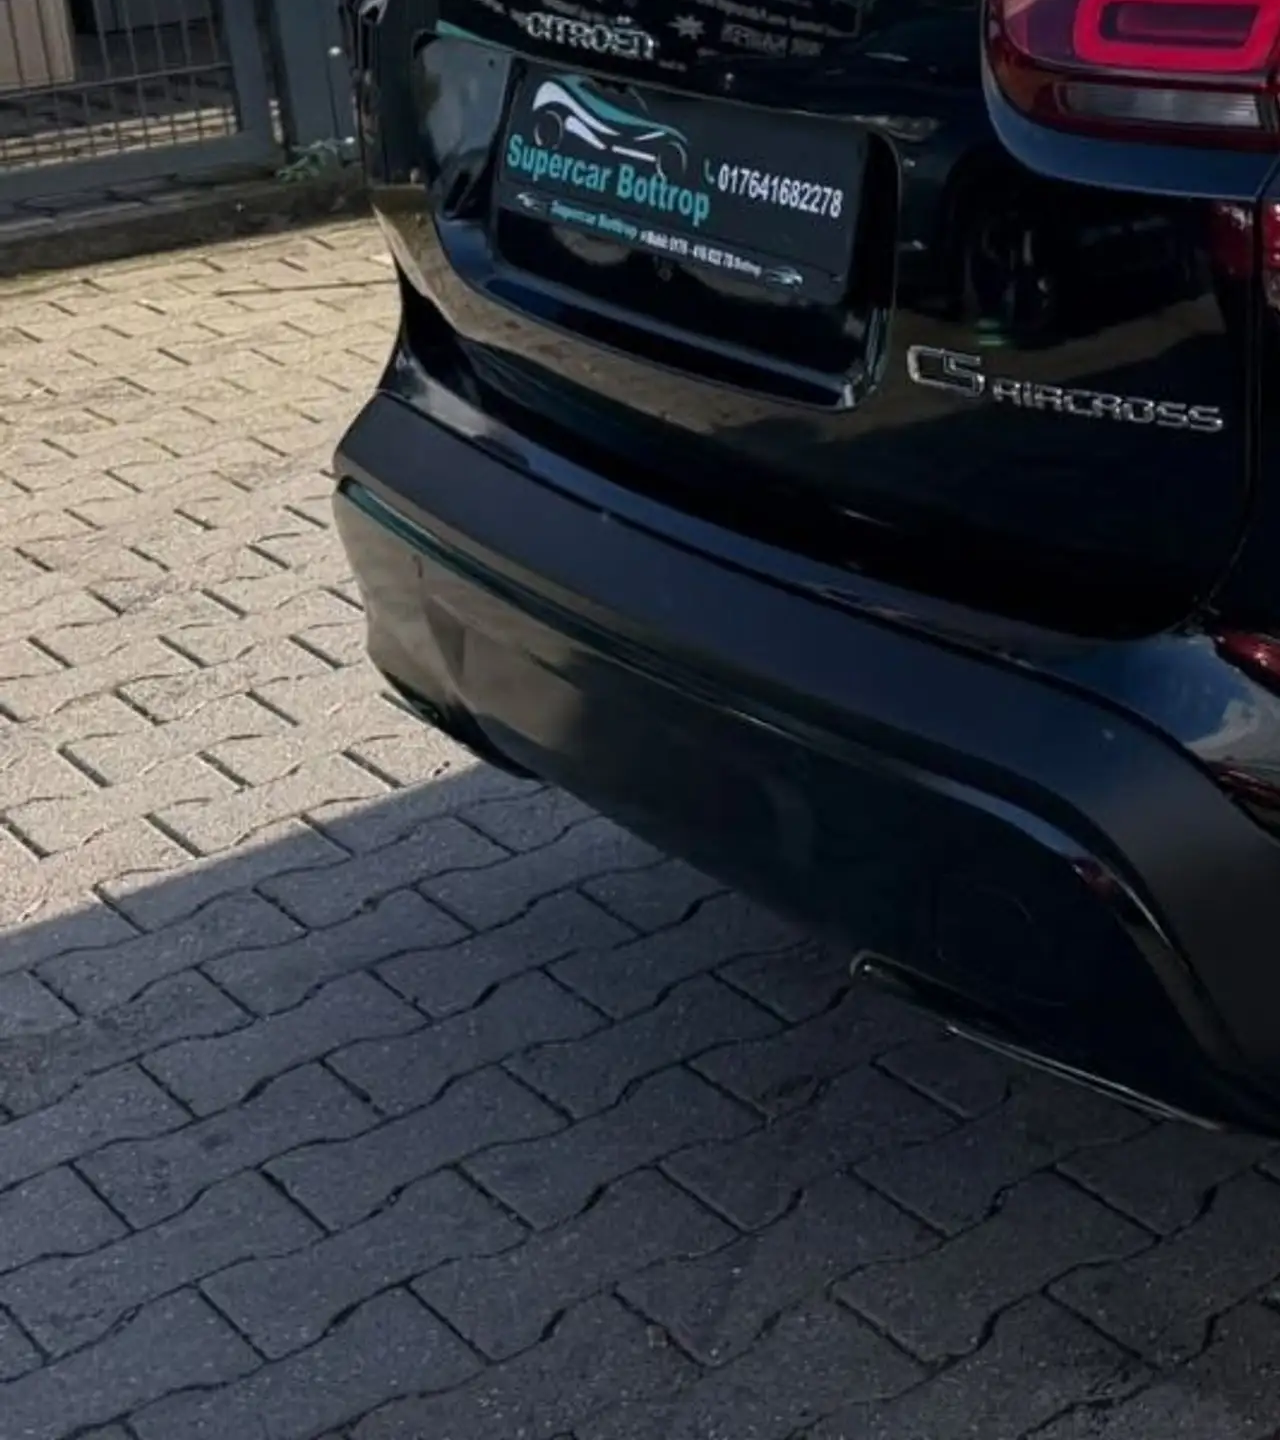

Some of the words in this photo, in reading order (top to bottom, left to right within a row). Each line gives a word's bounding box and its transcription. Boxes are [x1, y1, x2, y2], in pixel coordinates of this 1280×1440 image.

[507, 133, 613, 194] Supercar
[616, 162, 710, 228] Bottrop
[717, 163, 845, 219] 017641682278
[906, 344, 986, 398] C5
[992, 376, 1225, 433] AIRCROSS
